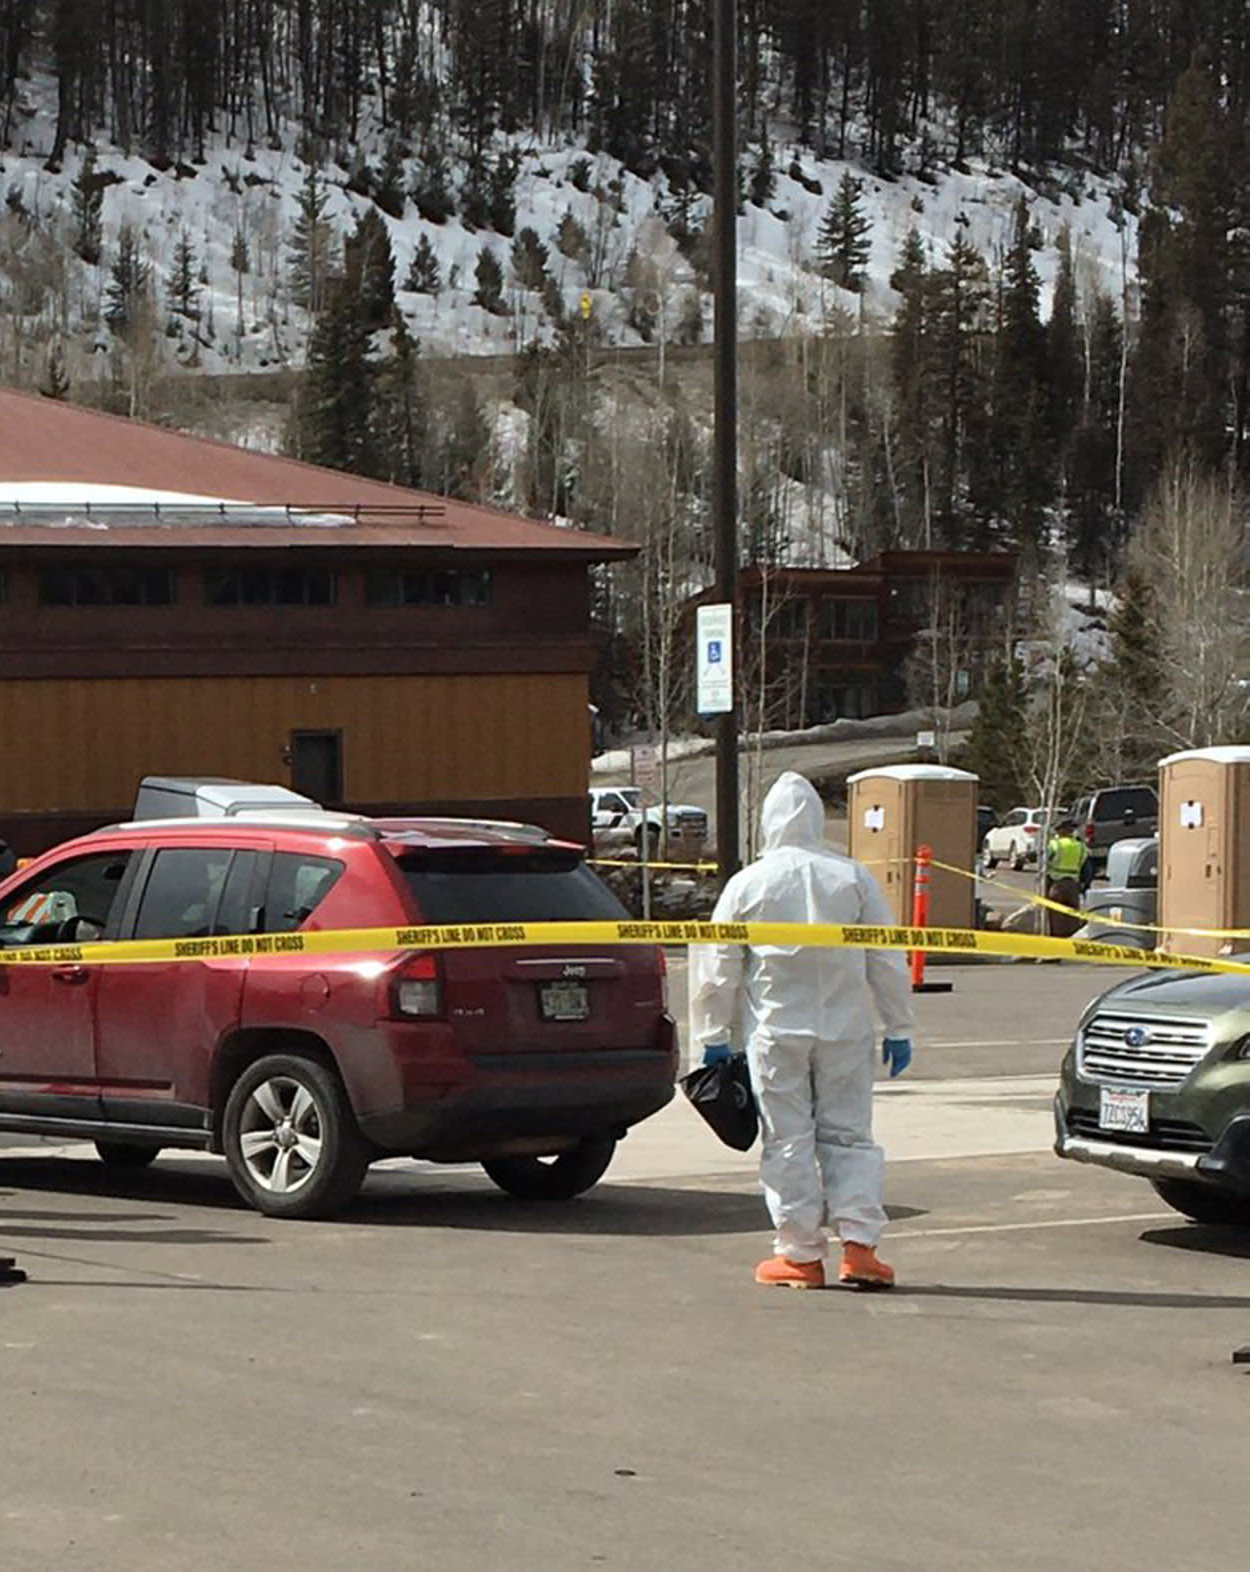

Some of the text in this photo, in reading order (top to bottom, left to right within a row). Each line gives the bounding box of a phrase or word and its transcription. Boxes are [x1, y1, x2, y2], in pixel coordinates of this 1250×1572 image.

[396, 925, 526, 945] SHERIFF'S LINE DO NOT CROSS
[617, 924, 749, 939] SHERIFF'S LINE DO NOT CROSS
[842, 927, 977, 948] SHERIFF'S LINE DO NOT CROSS
[175, 935, 304, 957] SHERIFF'S LINE DO NOT CROSS
